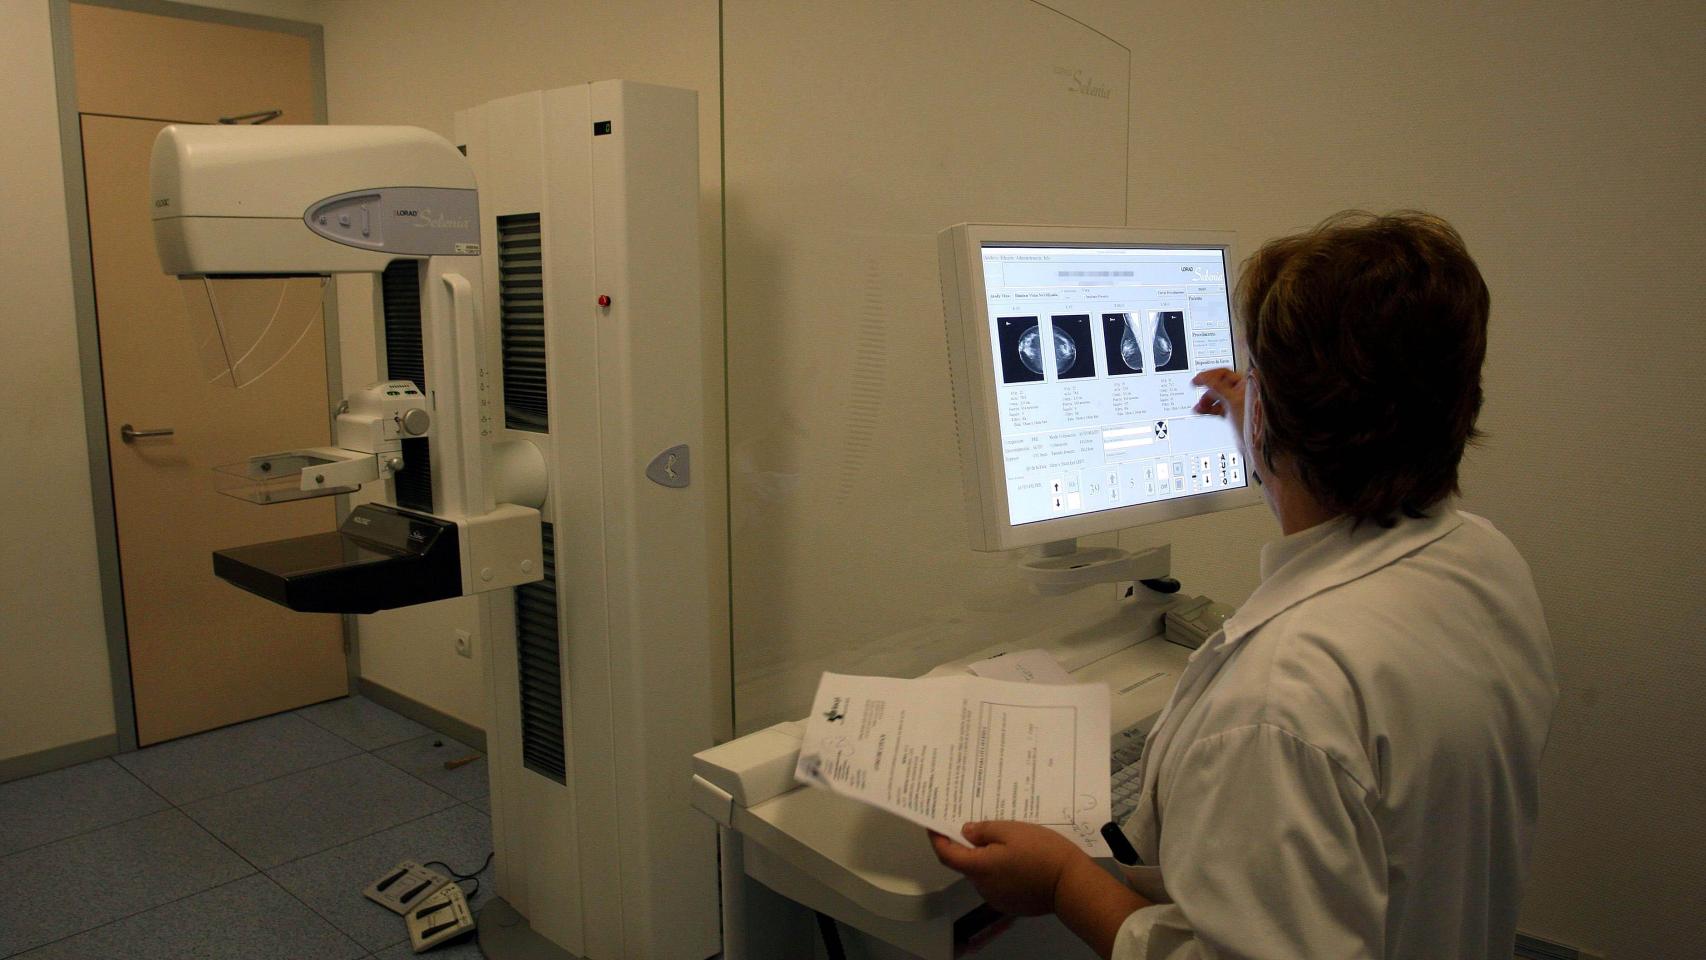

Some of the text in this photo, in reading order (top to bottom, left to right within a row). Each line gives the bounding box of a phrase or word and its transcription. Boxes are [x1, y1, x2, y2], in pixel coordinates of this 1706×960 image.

[396, 208, 470, 229] LORAD Selenia
[1220, 453, 1228, 486] AUTO
